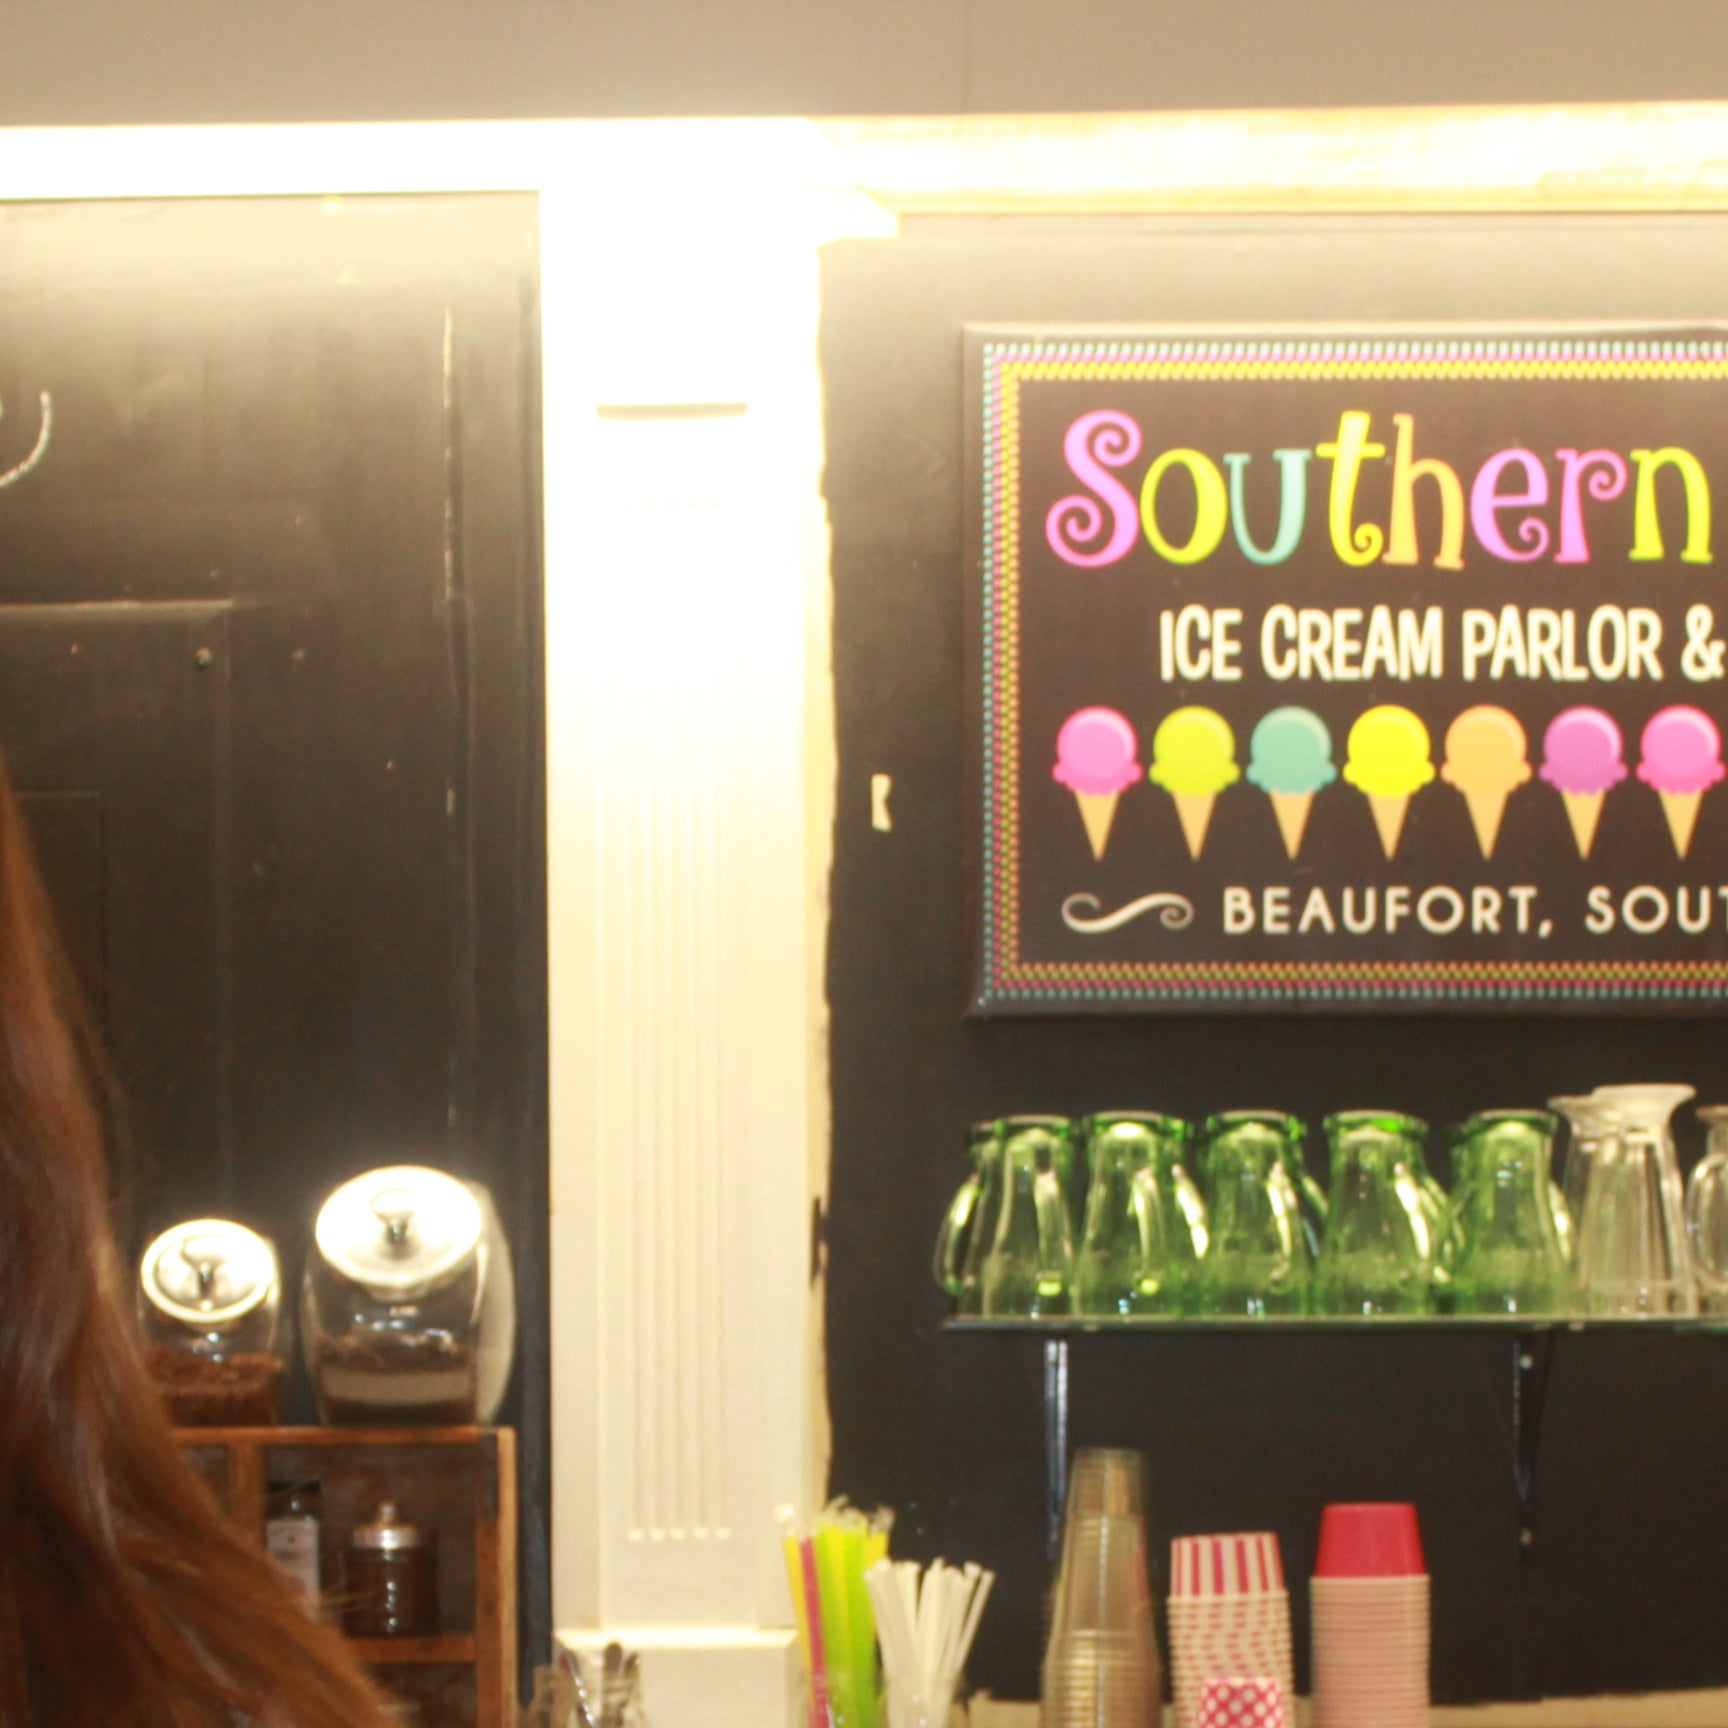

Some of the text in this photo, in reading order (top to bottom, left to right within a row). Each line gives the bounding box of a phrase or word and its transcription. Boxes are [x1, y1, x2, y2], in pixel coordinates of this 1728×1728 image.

[1045, 409, 1713, 570] Southern
[1160, 606, 1242, 682] ICE
[1261, 604, 1443, 682] CREAM
[1461, 605, 1663, 682] PARLOR
[1680, 605, 1726, 682] &
[1223, 885, 1554, 939] BEAUFORT,
